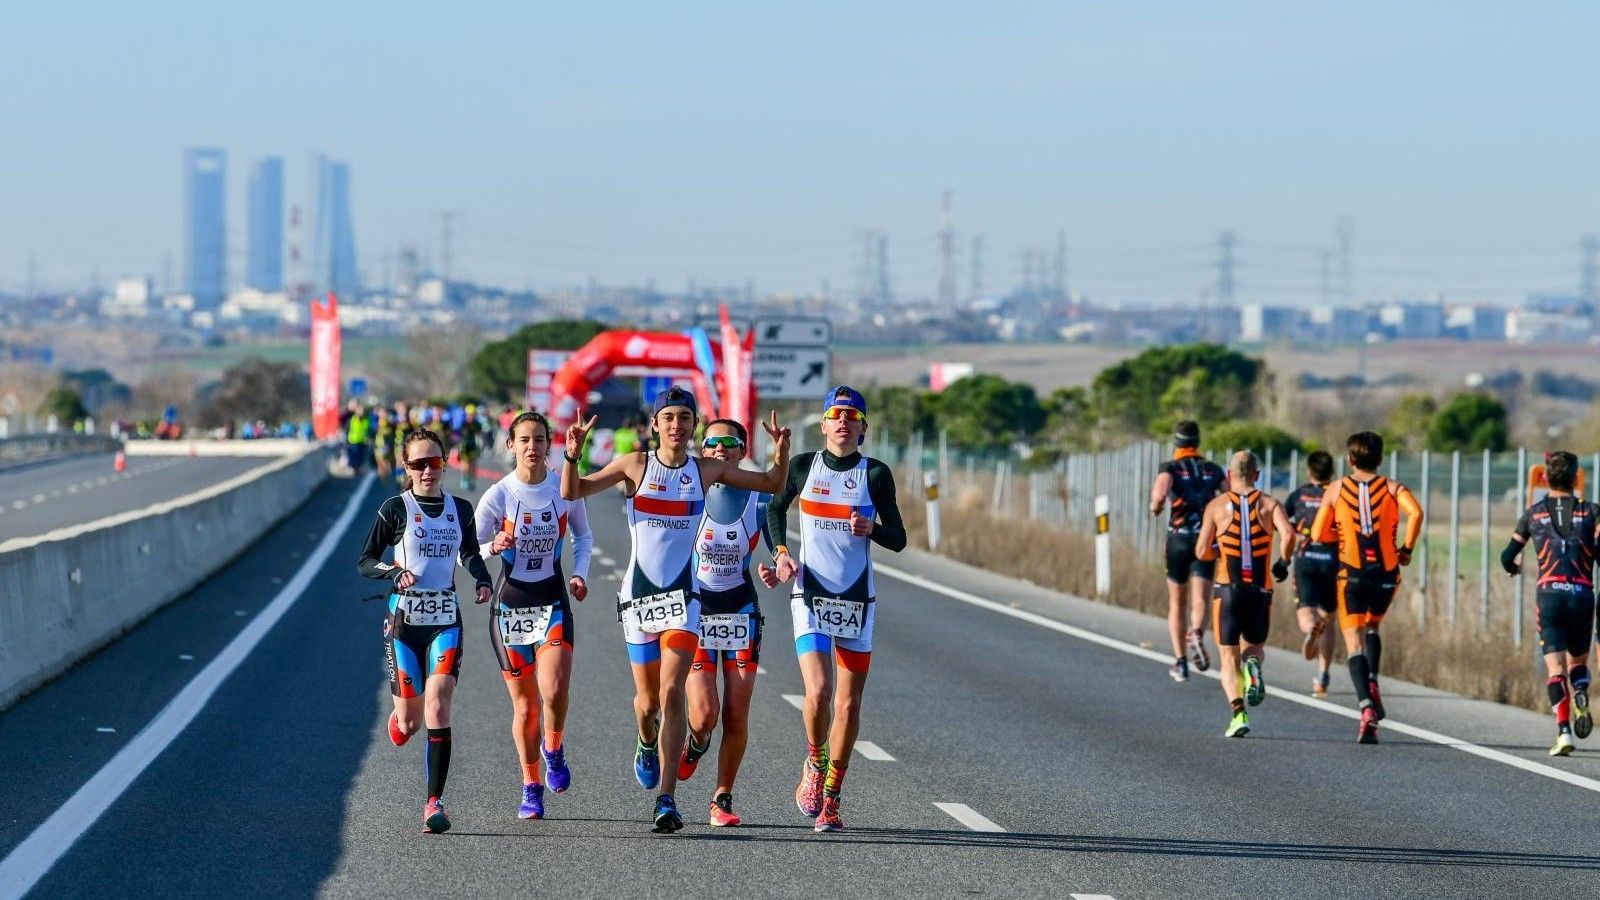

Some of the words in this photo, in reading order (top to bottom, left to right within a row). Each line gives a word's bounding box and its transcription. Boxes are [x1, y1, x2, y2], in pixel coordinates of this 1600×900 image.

[647, 517, 690, 530] FERNÁNDEZ
[418, 543, 453, 558] HELEN
[519, 538, 554, 553] ZORZO
[701, 552, 740, 566] ORGEIRA
[407, 599, 454, 615] 143-E
[636, 602, 684, 624] 143-B
[816, 608, 859, 628] 143-A
[700, 625, 748, 639] 143-D
